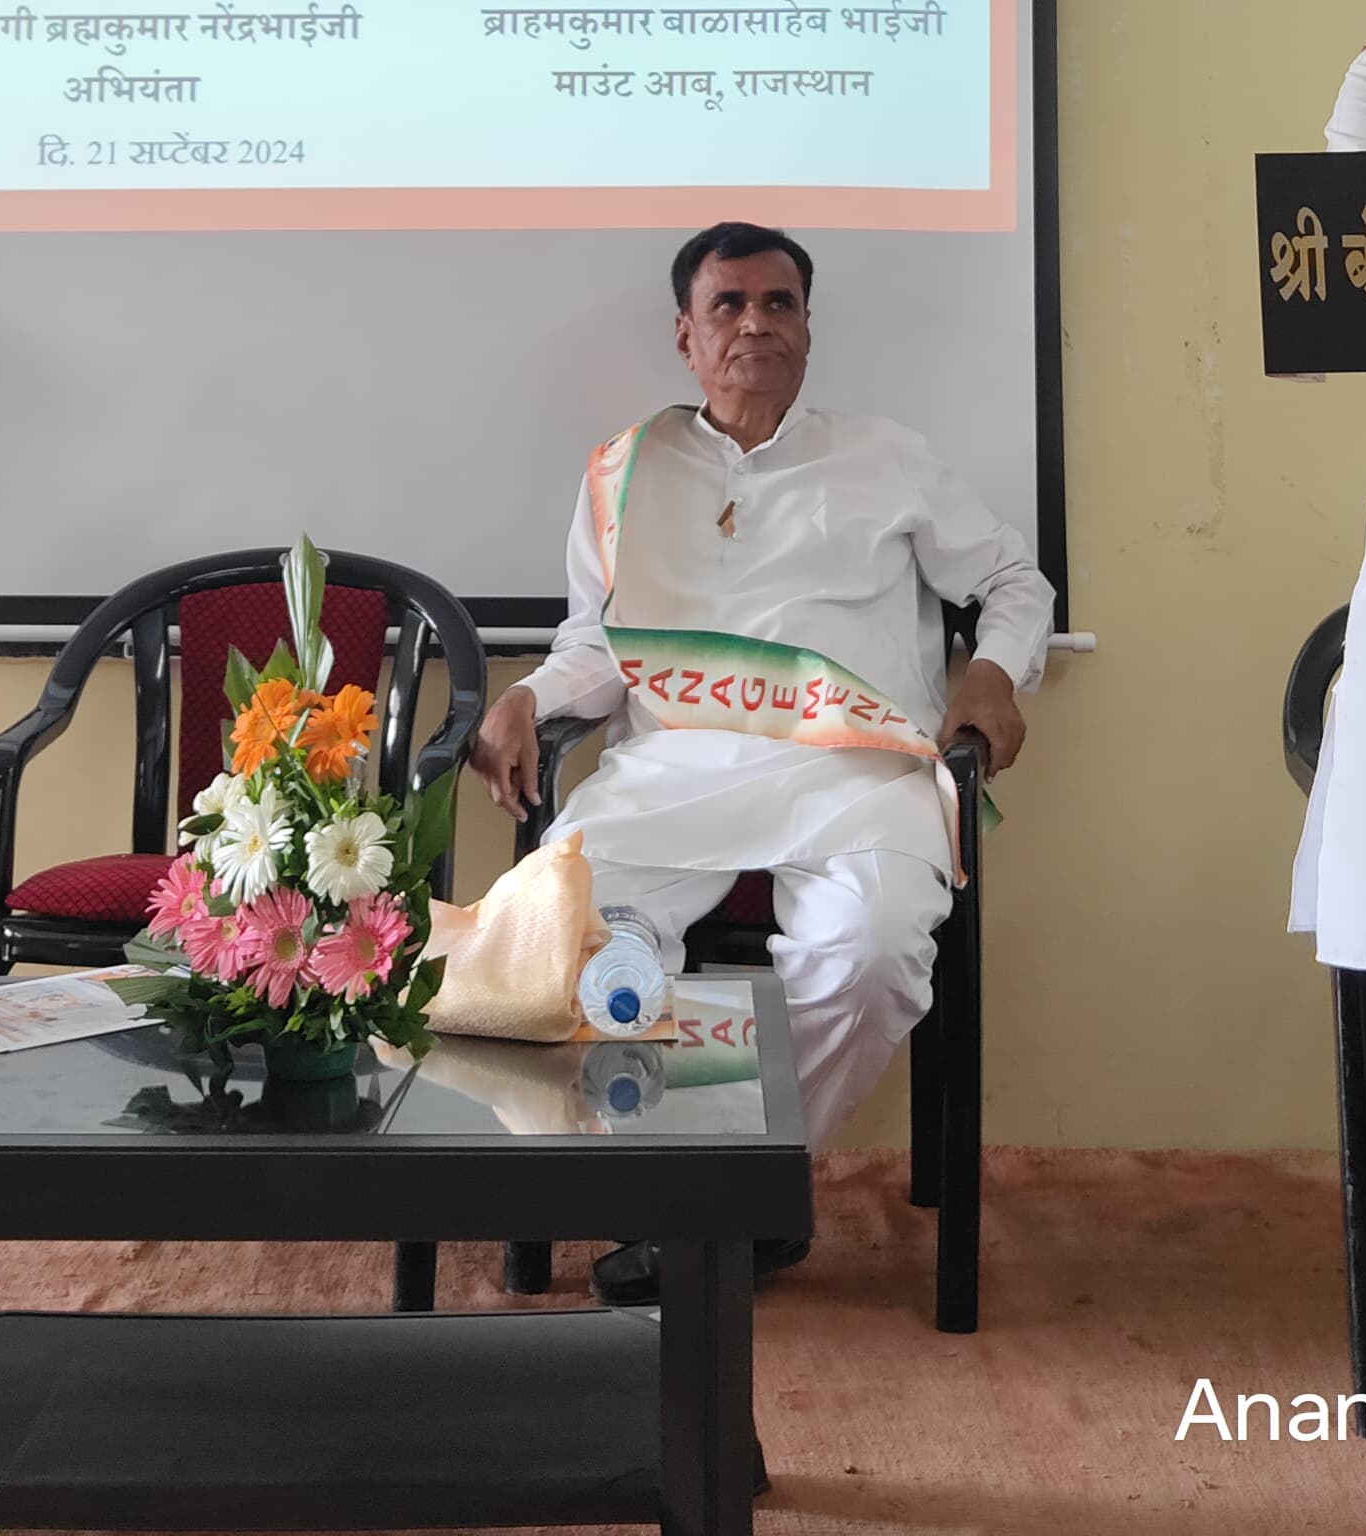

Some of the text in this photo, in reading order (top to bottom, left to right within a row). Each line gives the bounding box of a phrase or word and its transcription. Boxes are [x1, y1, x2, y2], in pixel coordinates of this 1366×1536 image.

[44, 15, 191, 56] ब्रह्मकुमार
[198, 2, 363, 47] नरेंद्रभाईजी
[64, 65, 201, 102] अभियंता
[552, 64, 874, 111] माउंट आबू, राजस्थान
[39, 132, 305, 166] दि. 21 सप्टेंबर 2024
[1270, 207, 1328, 301] श्री
[619, 657, 908, 725] MANAGEMENT
